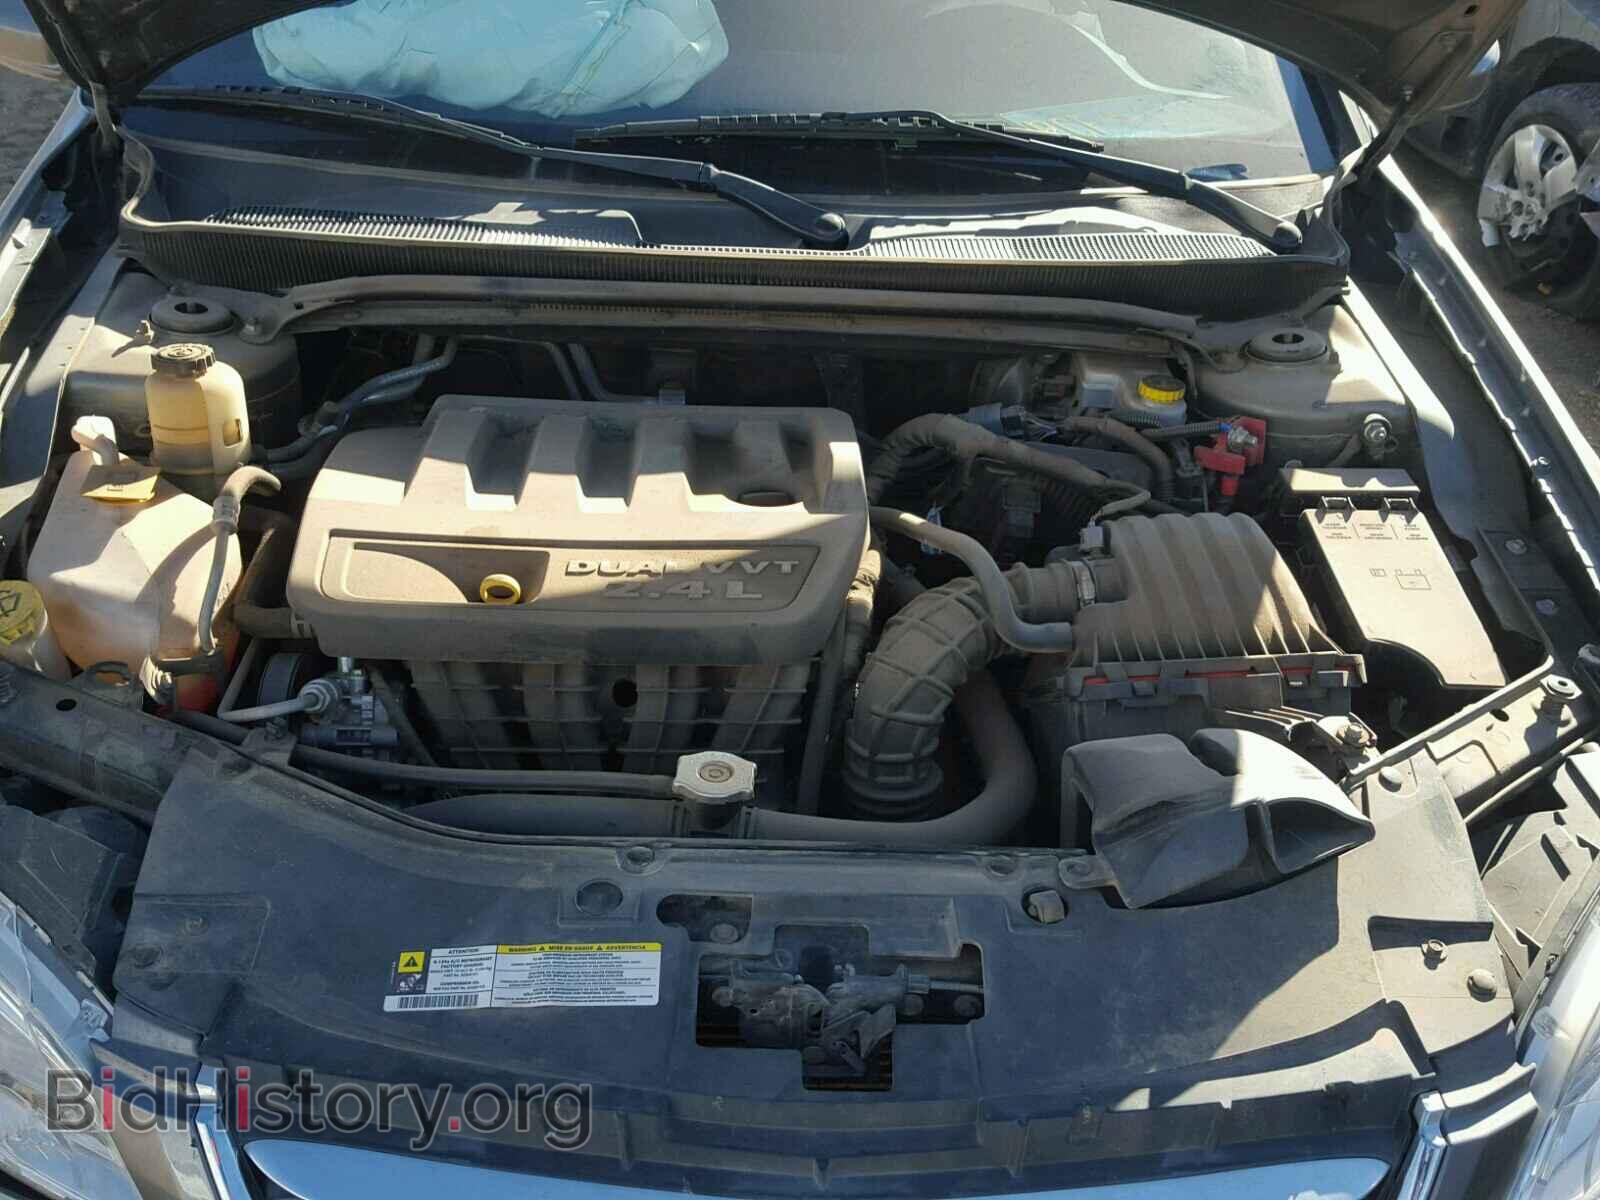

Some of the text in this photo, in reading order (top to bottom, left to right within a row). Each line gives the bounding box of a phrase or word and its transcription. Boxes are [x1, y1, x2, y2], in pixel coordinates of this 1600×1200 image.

[565, 560, 800, 577] DUAL VVT
[604, 579, 763, 600] 2.4L
